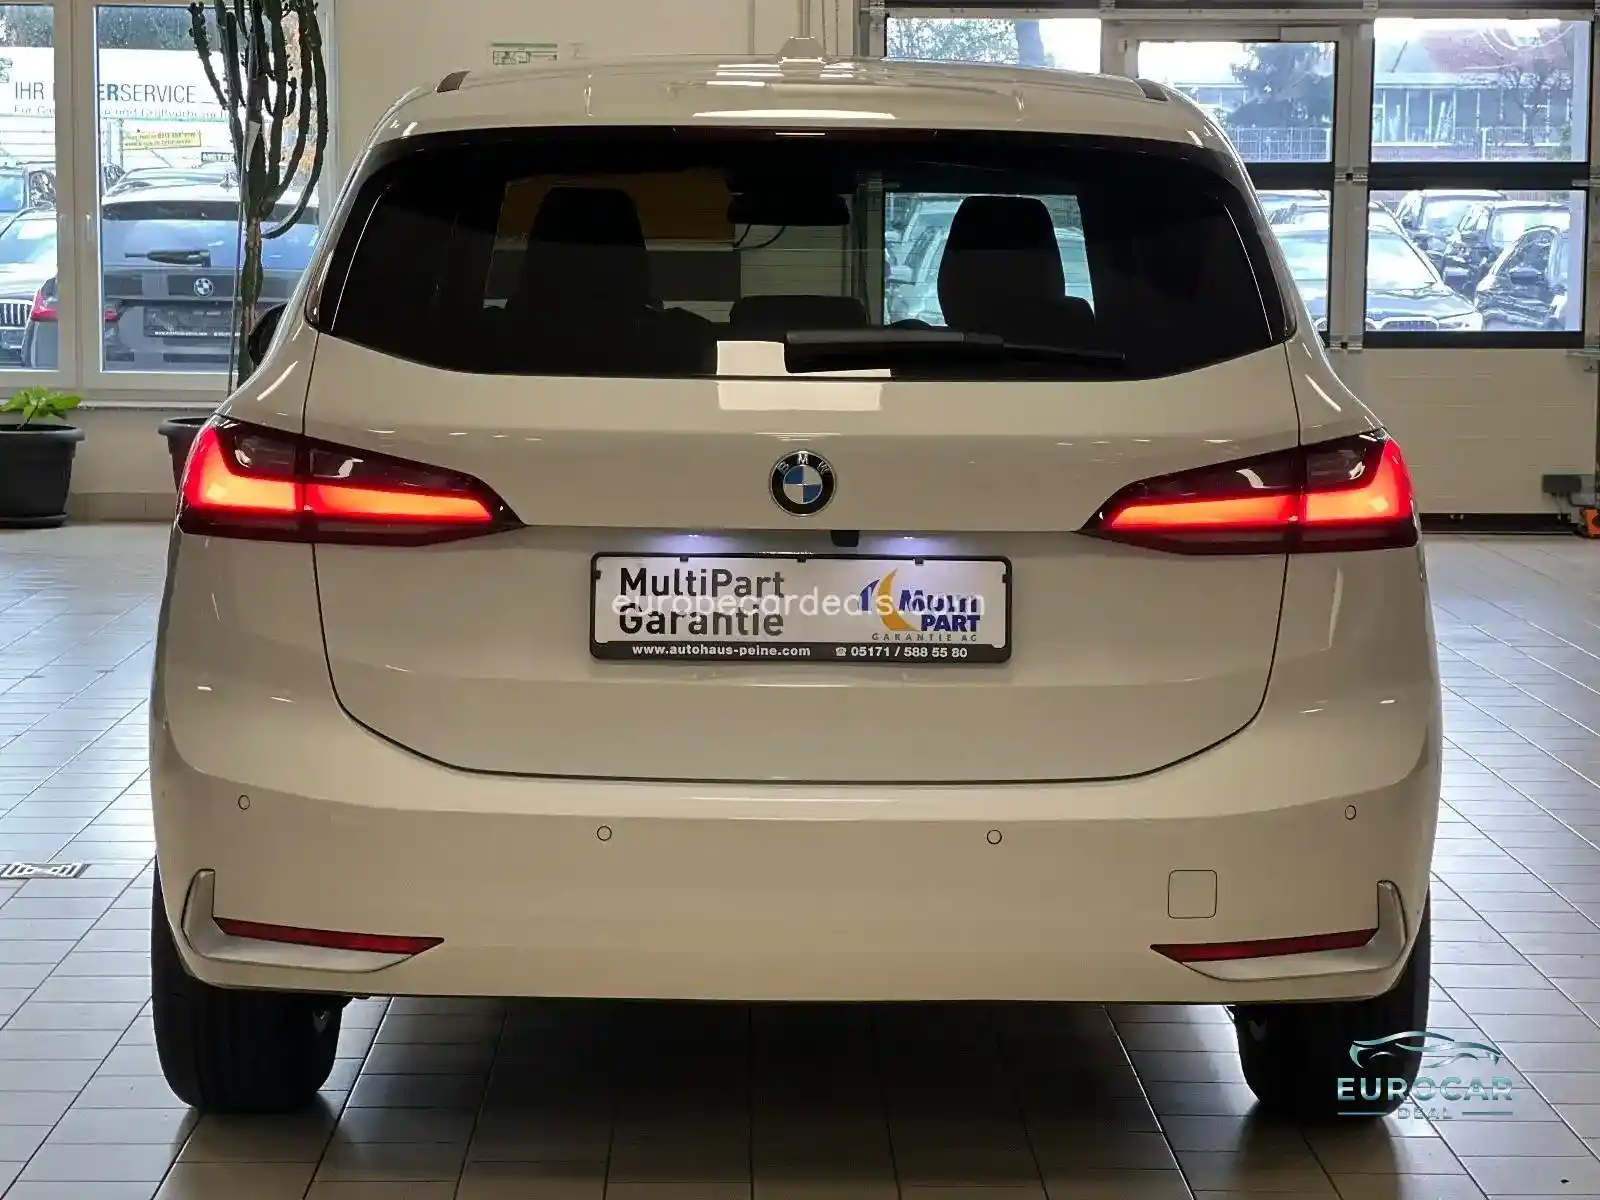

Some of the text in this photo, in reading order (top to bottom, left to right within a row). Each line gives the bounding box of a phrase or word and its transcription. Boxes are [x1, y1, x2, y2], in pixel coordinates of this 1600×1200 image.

[14, 81, 44, 100] IHR
[776, 452, 830, 476] BMW
[620, 567, 785, 598] MultiPart
[619, 602, 784, 636] Garantie
[920, 614, 980, 632] PART
[871, 632, 977, 642] GARANTIE AG
[631, 643, 811, 657] www.autohaus-peine.com
[850, 646, 890, 657] 05171
[903, 647, 928, 658] 588
[931, 647, 949, 658] 55
[951, 647, 968, 658] 80
